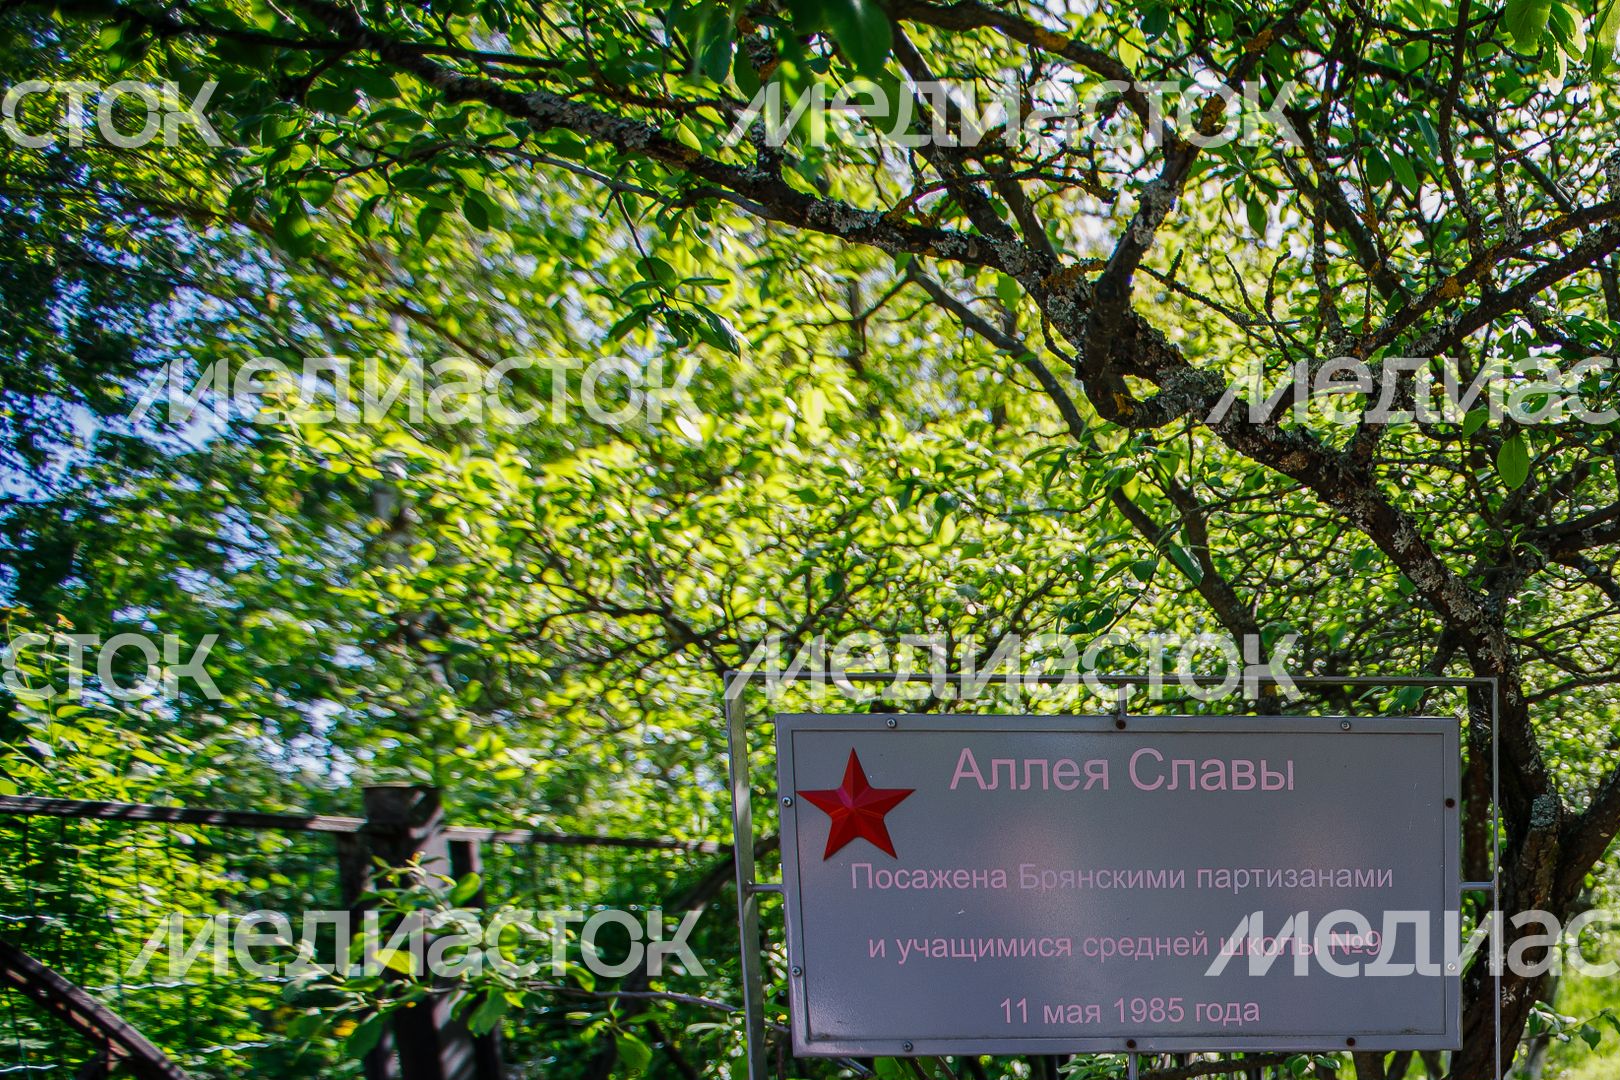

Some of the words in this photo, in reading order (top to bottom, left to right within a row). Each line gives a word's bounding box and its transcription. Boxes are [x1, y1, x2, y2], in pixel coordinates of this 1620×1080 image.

[949, 747, 1110, 792] Аллея
[1127, 747, 1296, 791] Славы
[850, 862, 1008, 890] Посажена
[1018, 863, 1186, 892] Брянскими
[1196, 867, 1394, 895] партизанами
[868, 938, 886, 958] и
[896, 935, 1072, 965] учащимися
[1083, 930, 1209, 962] средней
[1219, 936, 1320, 957] школы
[1330, 929, 1384, 957] №9
[999, 997, 1028, 1024] 11
[1043, 1002, 1102, 1024] мая
[1113, 996, 1186, 1024] 1985
[1195, 1000, 1262, 1027] года
